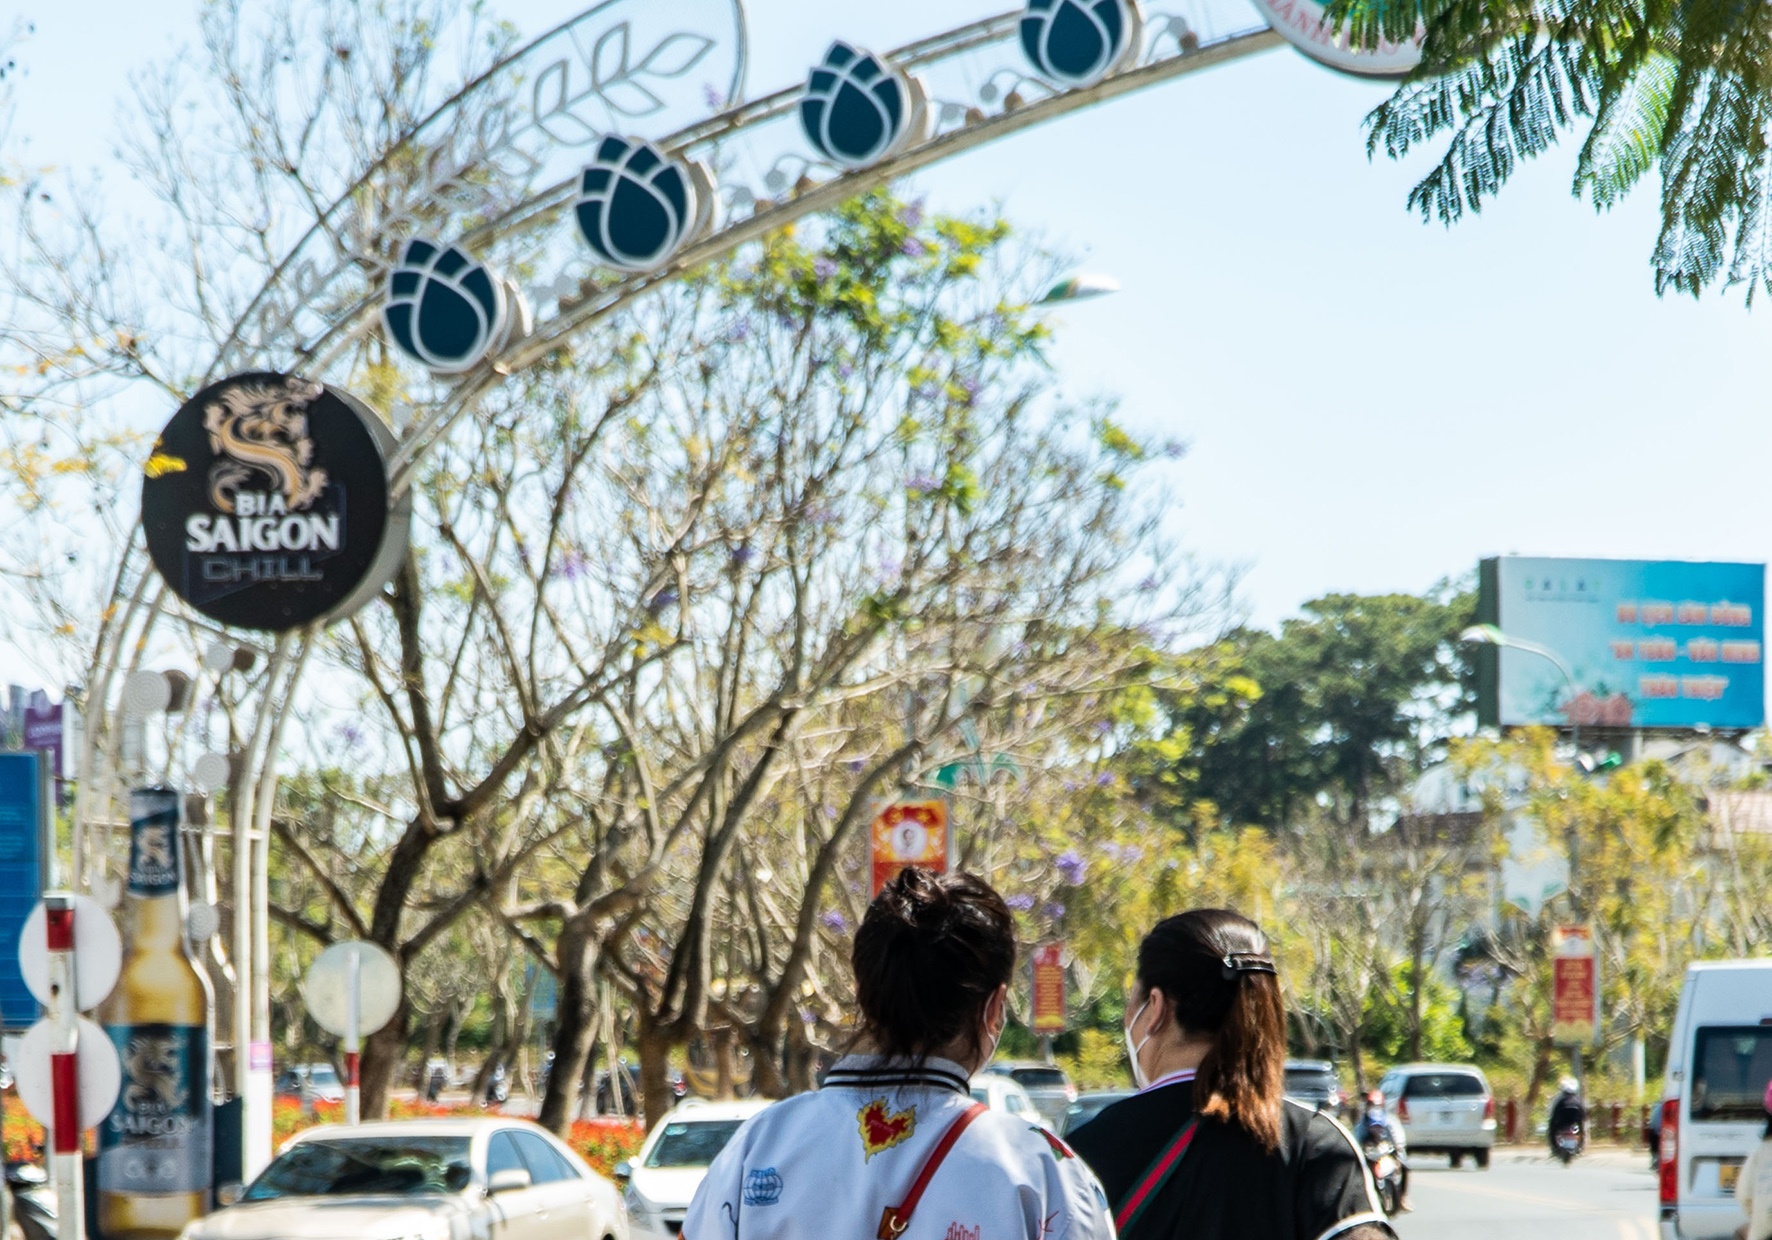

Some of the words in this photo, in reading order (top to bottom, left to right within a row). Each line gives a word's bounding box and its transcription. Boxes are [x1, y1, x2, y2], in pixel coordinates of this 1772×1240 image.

[235, 491, 287, 516] BIA
[185, 514, 341, 553] SAIGON
[202, 557, 323, 581] CHILL
[110, 1114, 193, 1135] SAIGON
